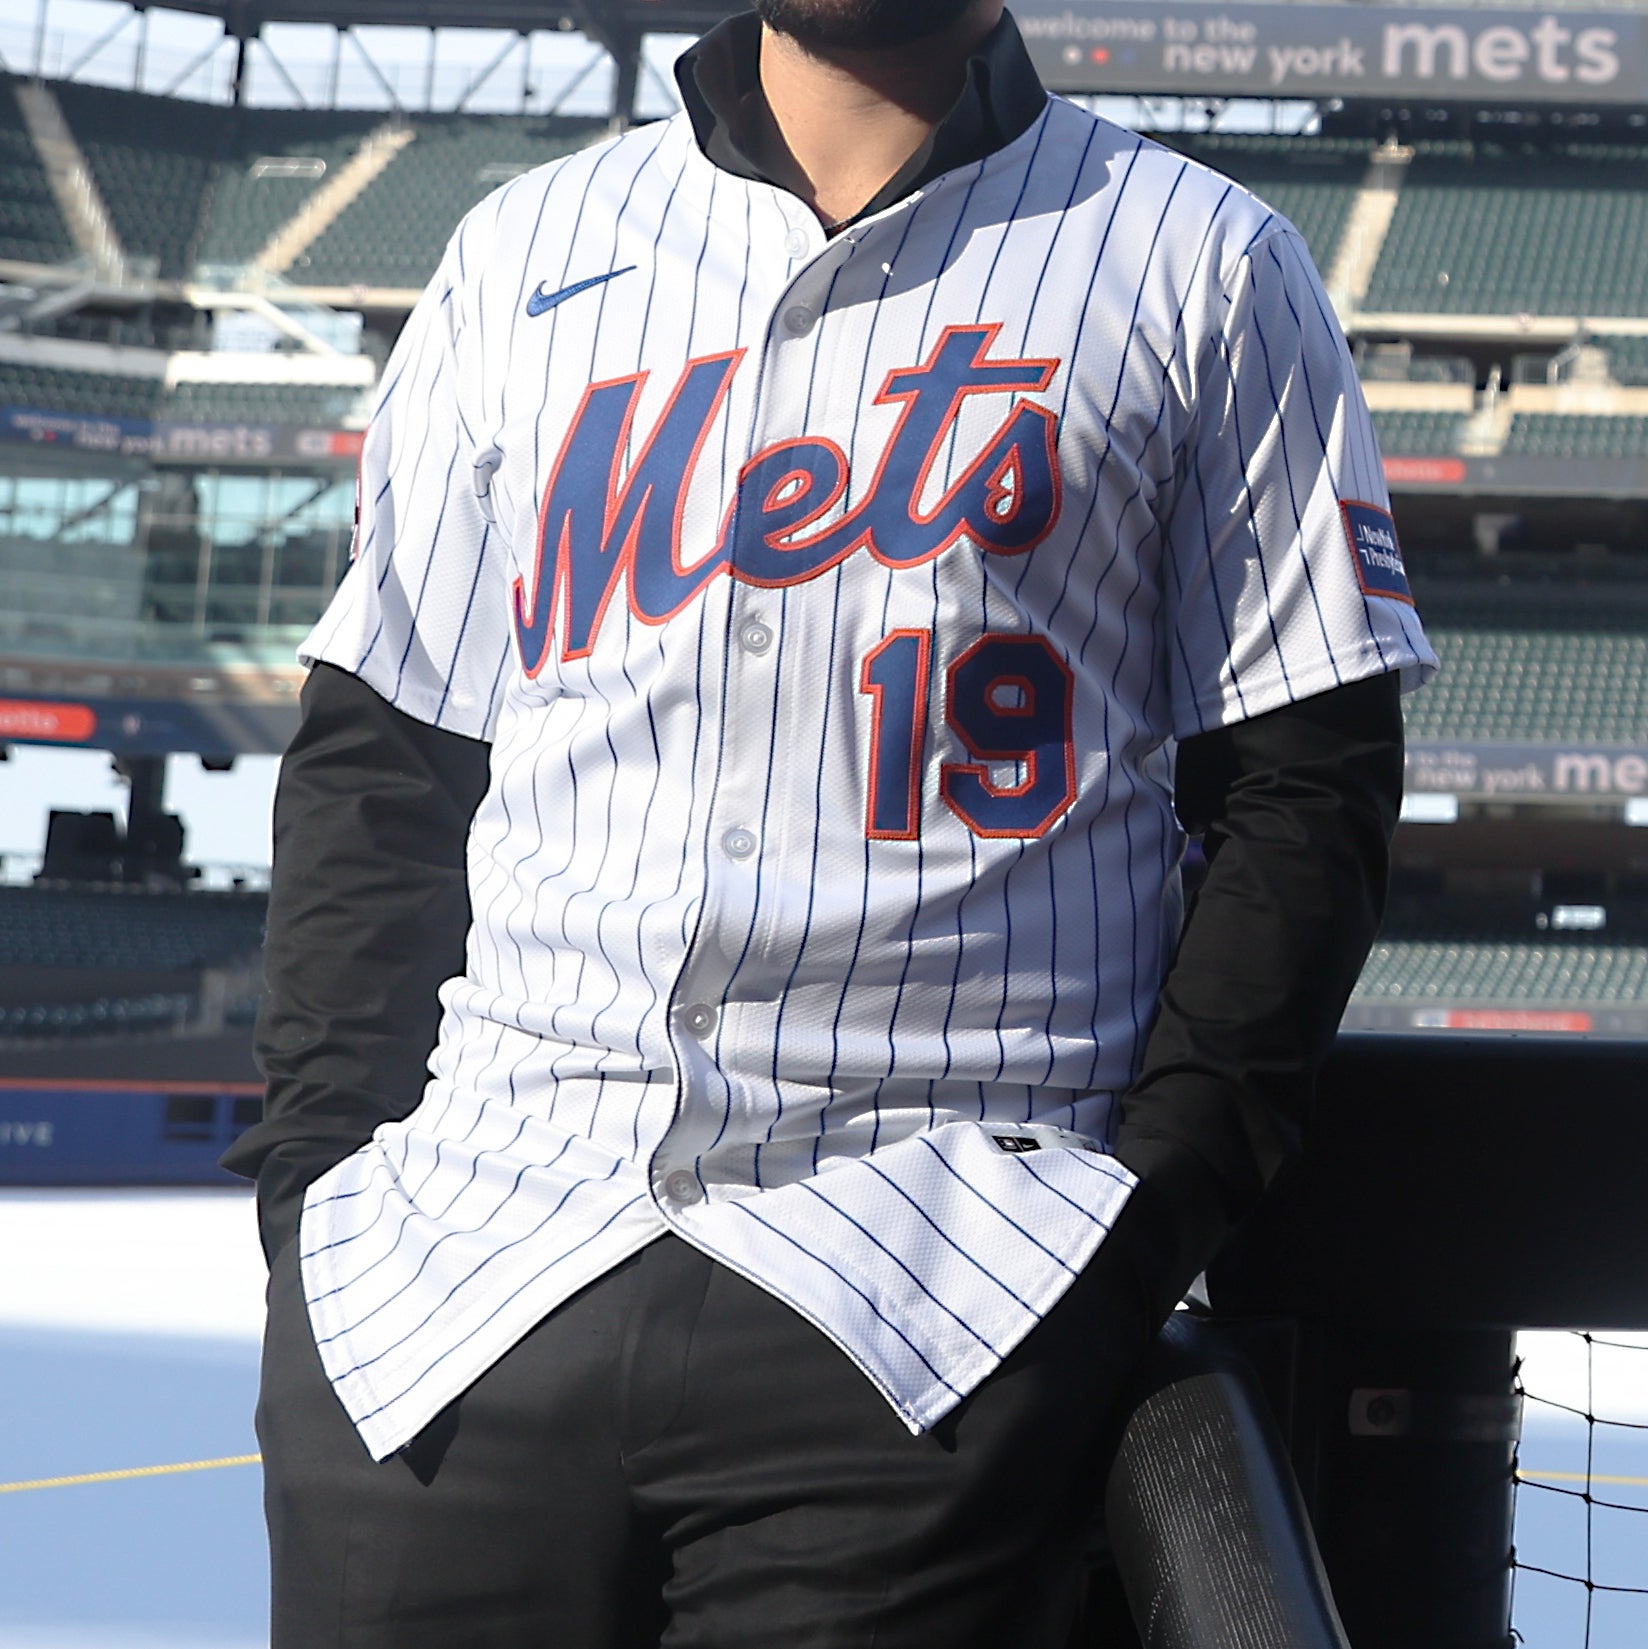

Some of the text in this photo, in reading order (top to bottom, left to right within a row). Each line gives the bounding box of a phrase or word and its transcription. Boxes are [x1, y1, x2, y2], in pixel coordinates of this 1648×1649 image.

[1019, 12, 1257, 44] welcome to the
[1162, 42, 1257, 73] new
[1269, 38, 1365, 86] york
[1382, 16, 1620, 84] mets
[512, 321, 1062, 679] Mets
[861, 626, 1077, 841] 19
[1481, 763, 1545, 794] york
